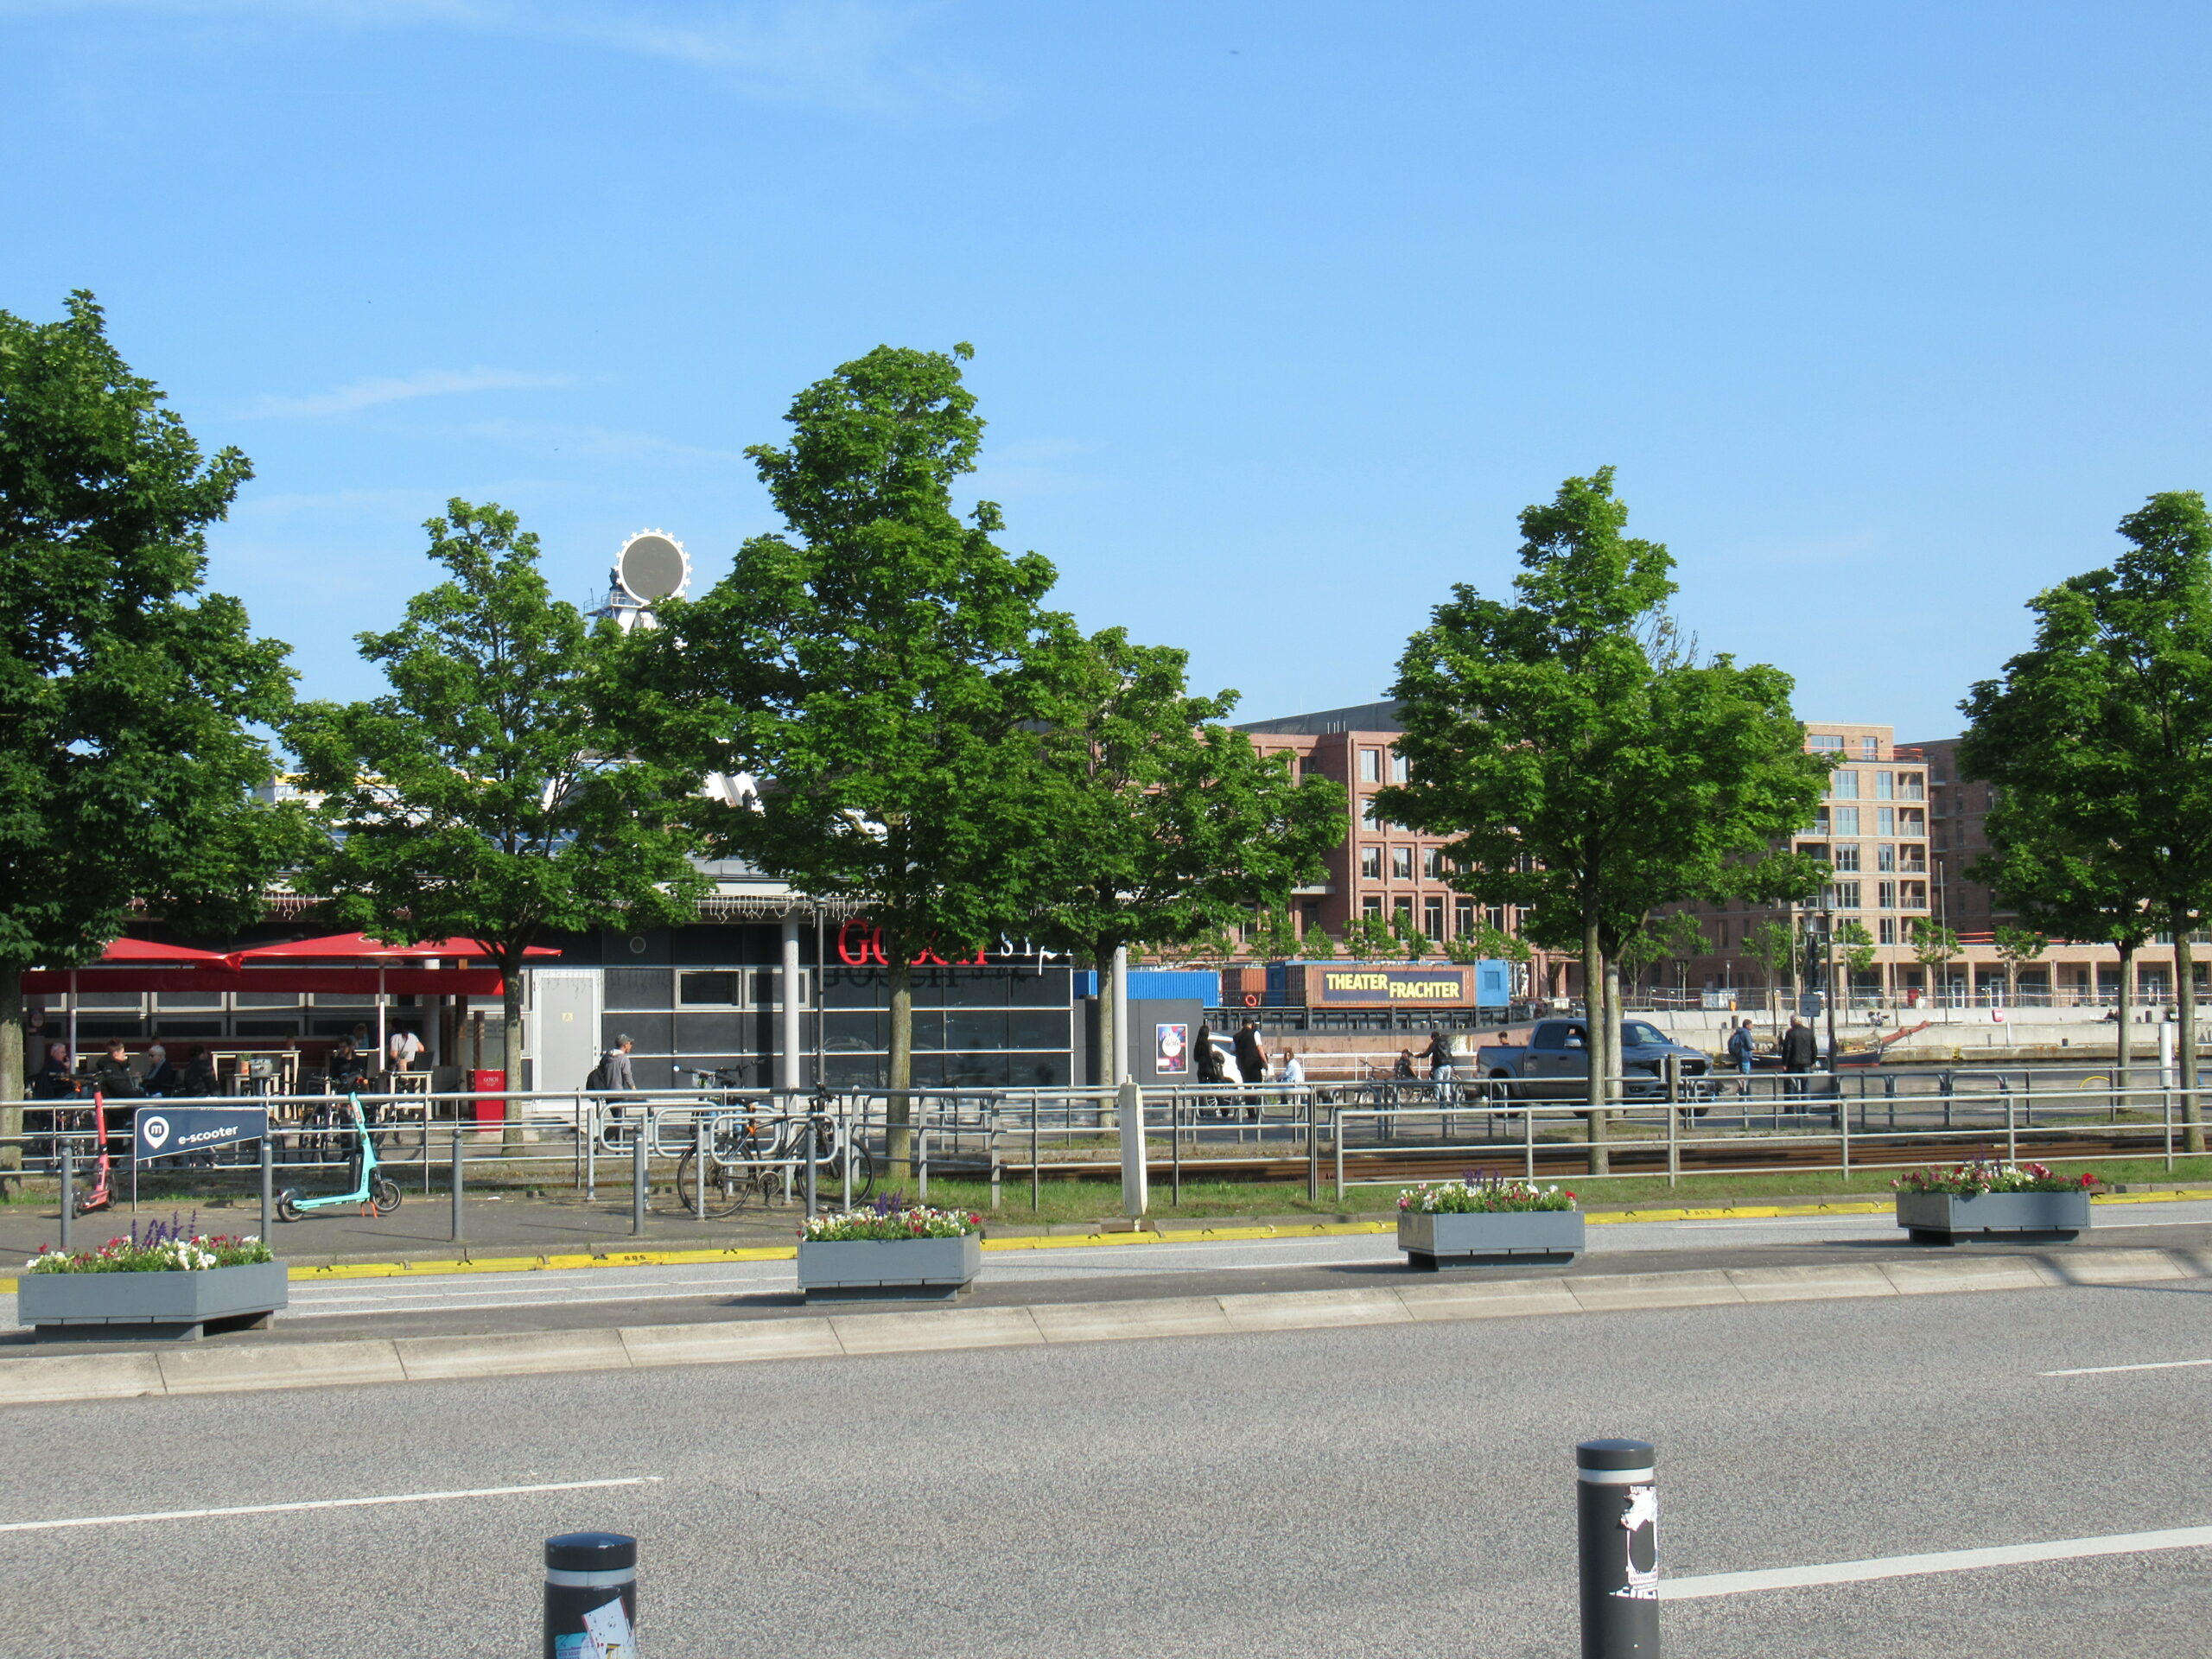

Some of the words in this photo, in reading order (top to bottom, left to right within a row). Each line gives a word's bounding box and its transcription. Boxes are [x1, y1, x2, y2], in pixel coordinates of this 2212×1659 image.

[1326, 974, 1388, 990] THEATER
[1389, 982, 1459, 998] FRACHTER
[178, 1126, 238, 1145] e-scooter
